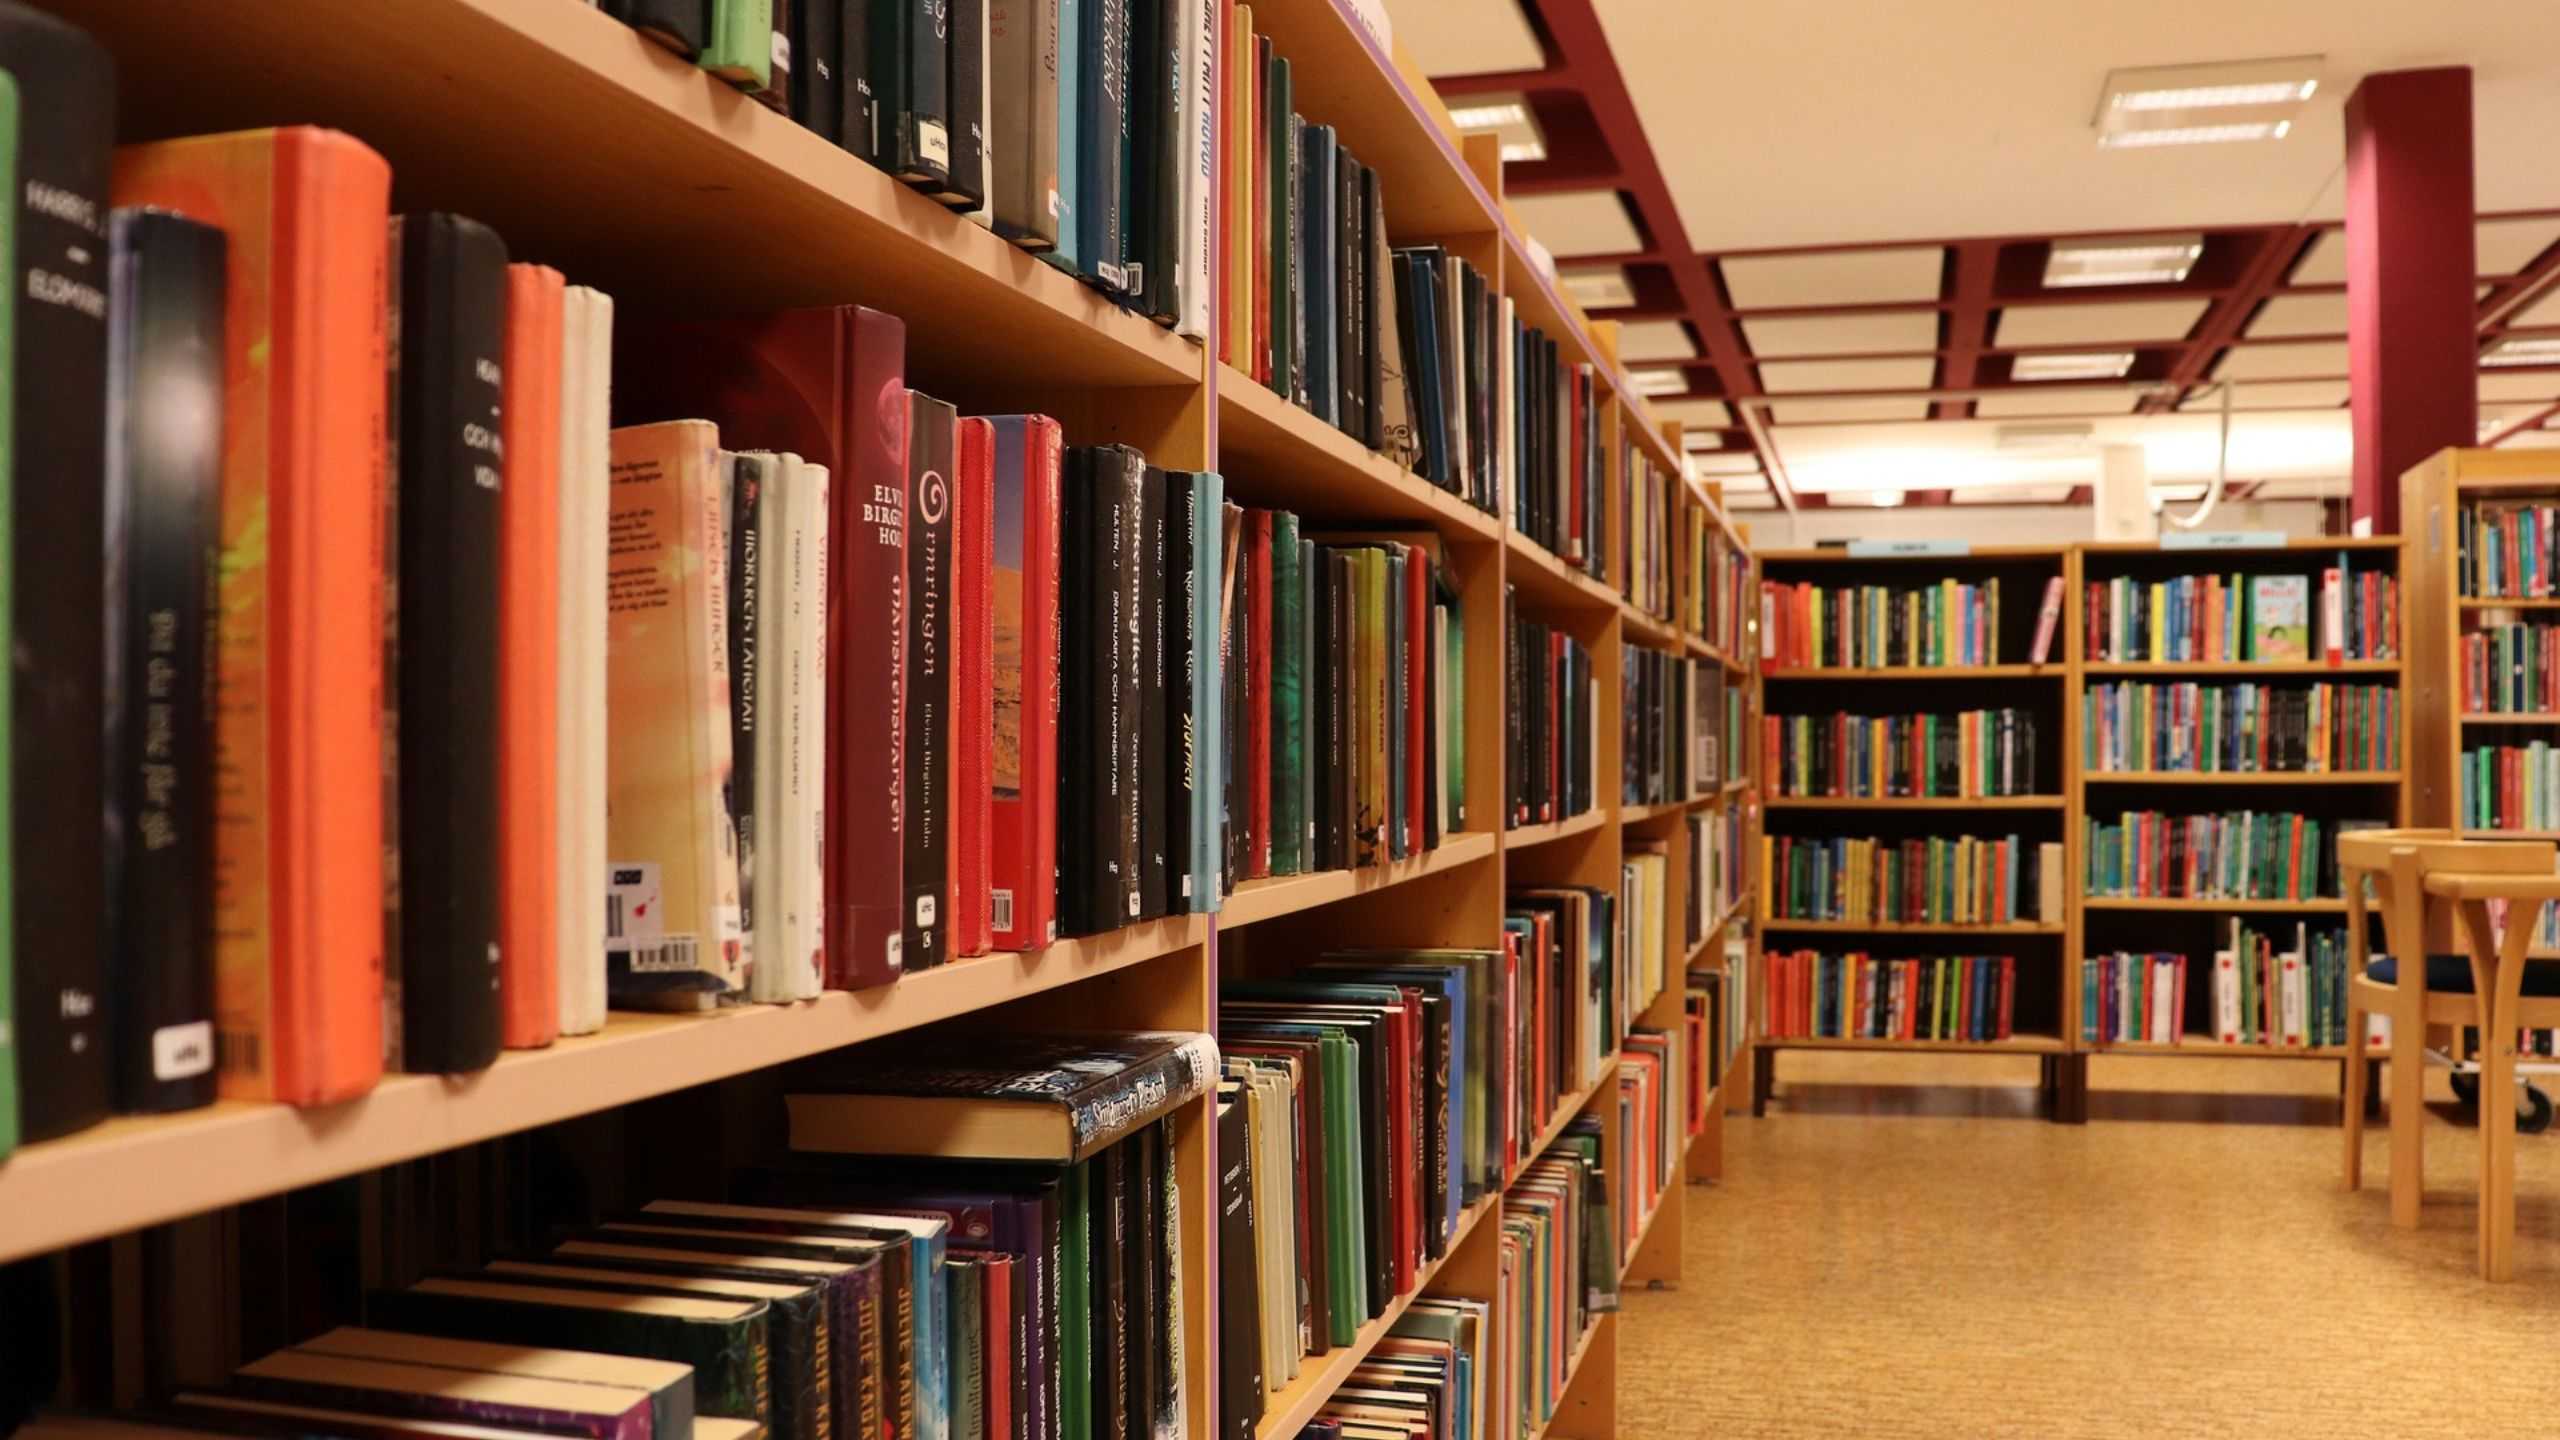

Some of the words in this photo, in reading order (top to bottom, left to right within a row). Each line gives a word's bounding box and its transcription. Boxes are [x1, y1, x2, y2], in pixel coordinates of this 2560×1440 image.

[858, 1299, 874, 1365] JULIE
[898, 1288, 913, 1352] JULIE
[816, 1326, 830, 1393] JULIE
